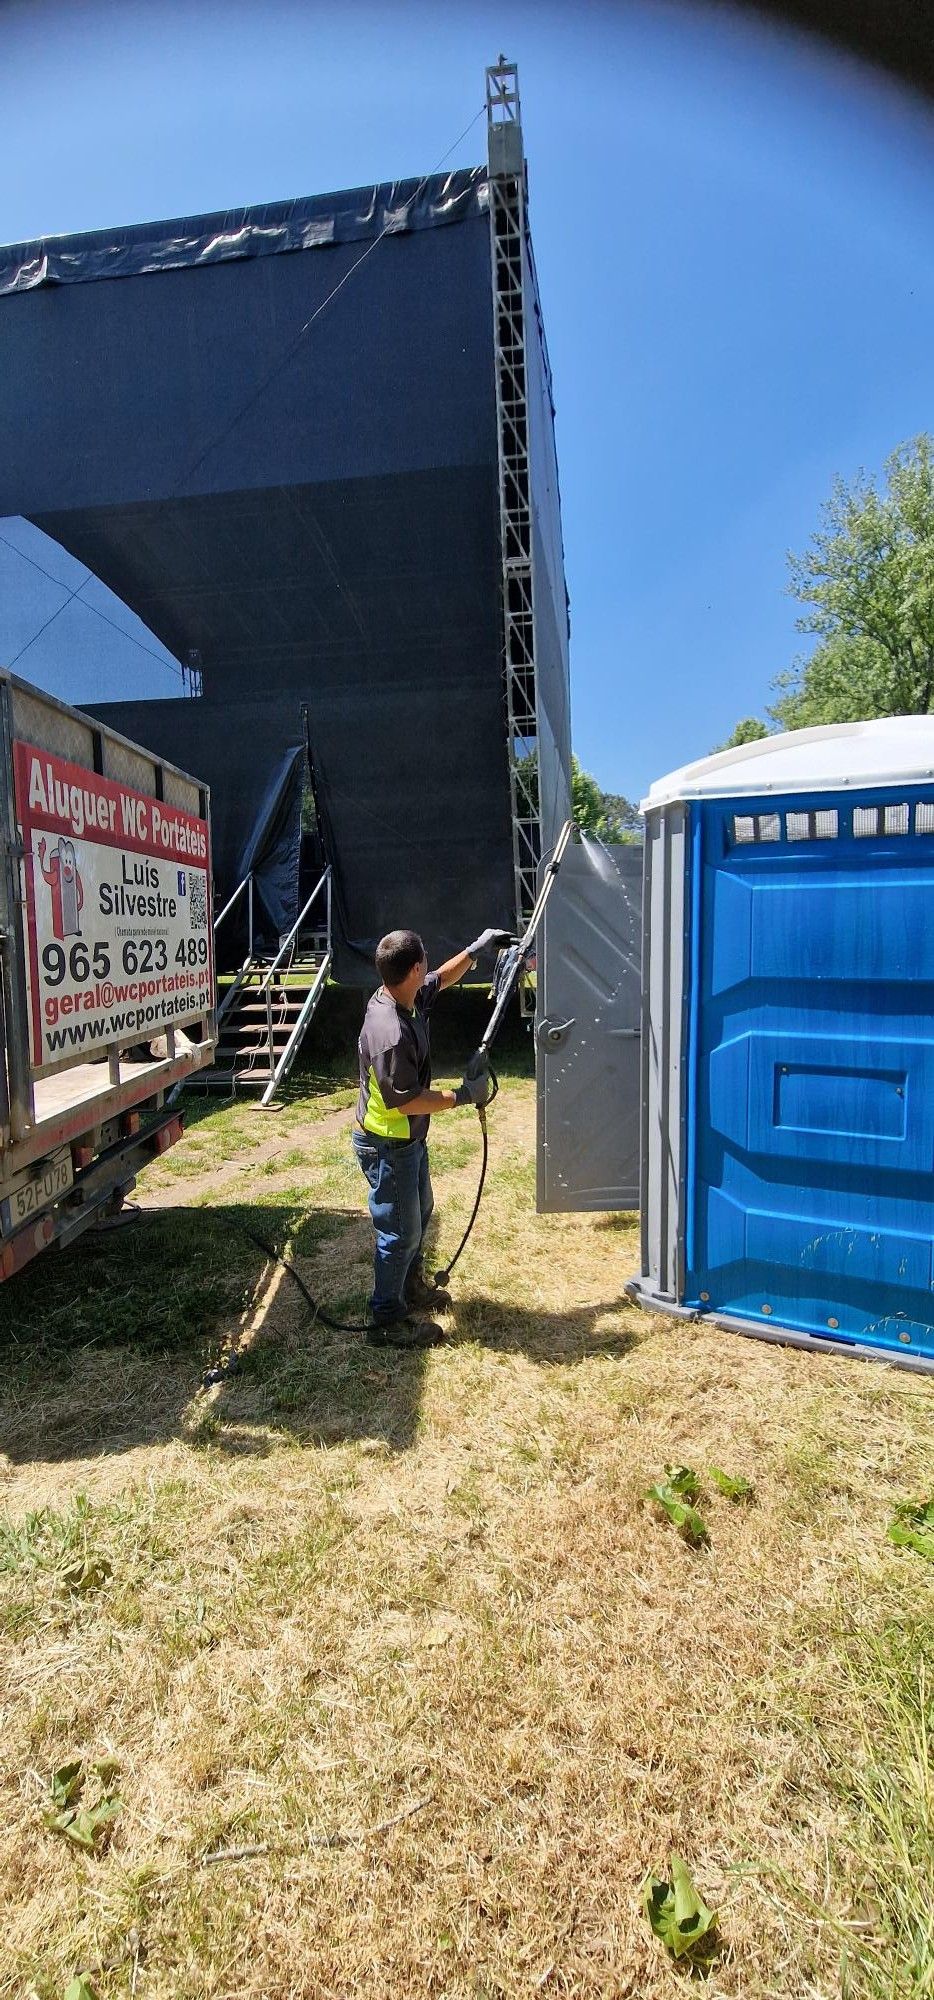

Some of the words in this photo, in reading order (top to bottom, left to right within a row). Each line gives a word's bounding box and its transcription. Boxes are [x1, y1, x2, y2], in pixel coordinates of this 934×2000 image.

[28, 757, 117, 835] Aluguer
[119, 793, 148, 841] WC
[151, 805, 207, 858] Portáteis
[121, 854, 160, 889] Luís
[99, 882, 177, 918] Silvestre
[42, 941, 111, 987] 965
[122, 939, 168, 976] 623
[175, 937, 208, 967] 489
[44, 969, 210, 1026] geral@wcportateis.pt
[45, 988, 211, 1052] www.wcportateis.pt
